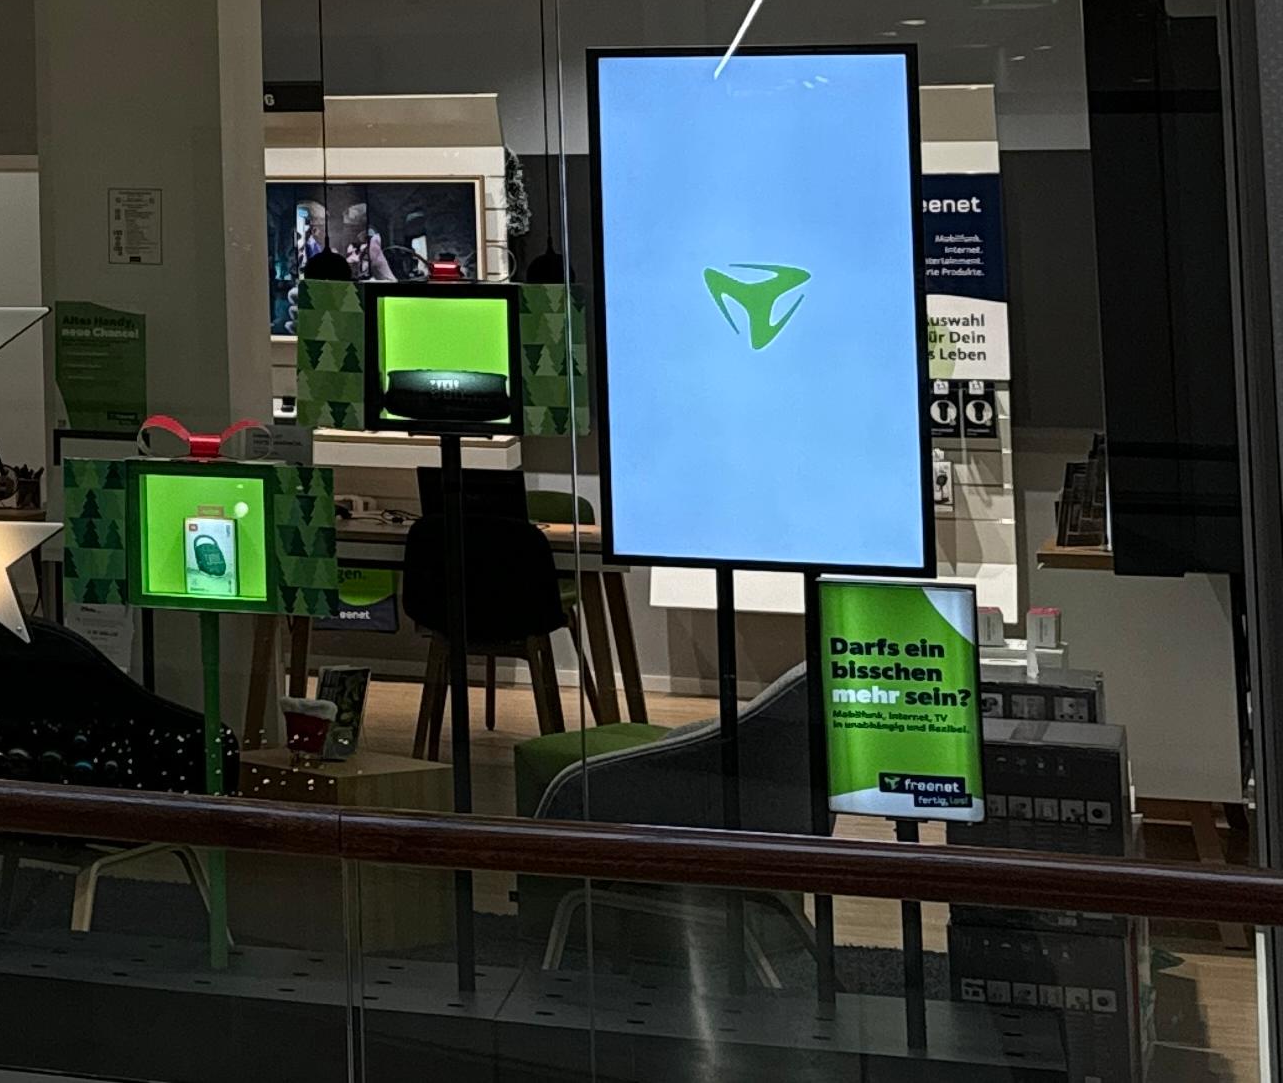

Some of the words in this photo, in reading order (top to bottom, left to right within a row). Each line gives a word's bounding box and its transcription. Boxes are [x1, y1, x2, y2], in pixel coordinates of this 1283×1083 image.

[922, 197, 982, 214] enet
[928, 330, 945, 344] ür
[949, 331, 986, 344] Dein
[939, 348, 987, 361] Leben
[339, 610, 371, 620] eenet
[830, 637, 900, 657] Darfs
[905, 638, 946, 658] ein
[831, 660, 943, 682] bisschen
[832, 685, 901, 704] mehr
[905, 686, 972, 706] sein?
[934, 714, 948, 723] TV
[907, 724, 926, 732] und
[904, 778, 961, 794] freenet
[918, 795, 949, 807] fertig,
